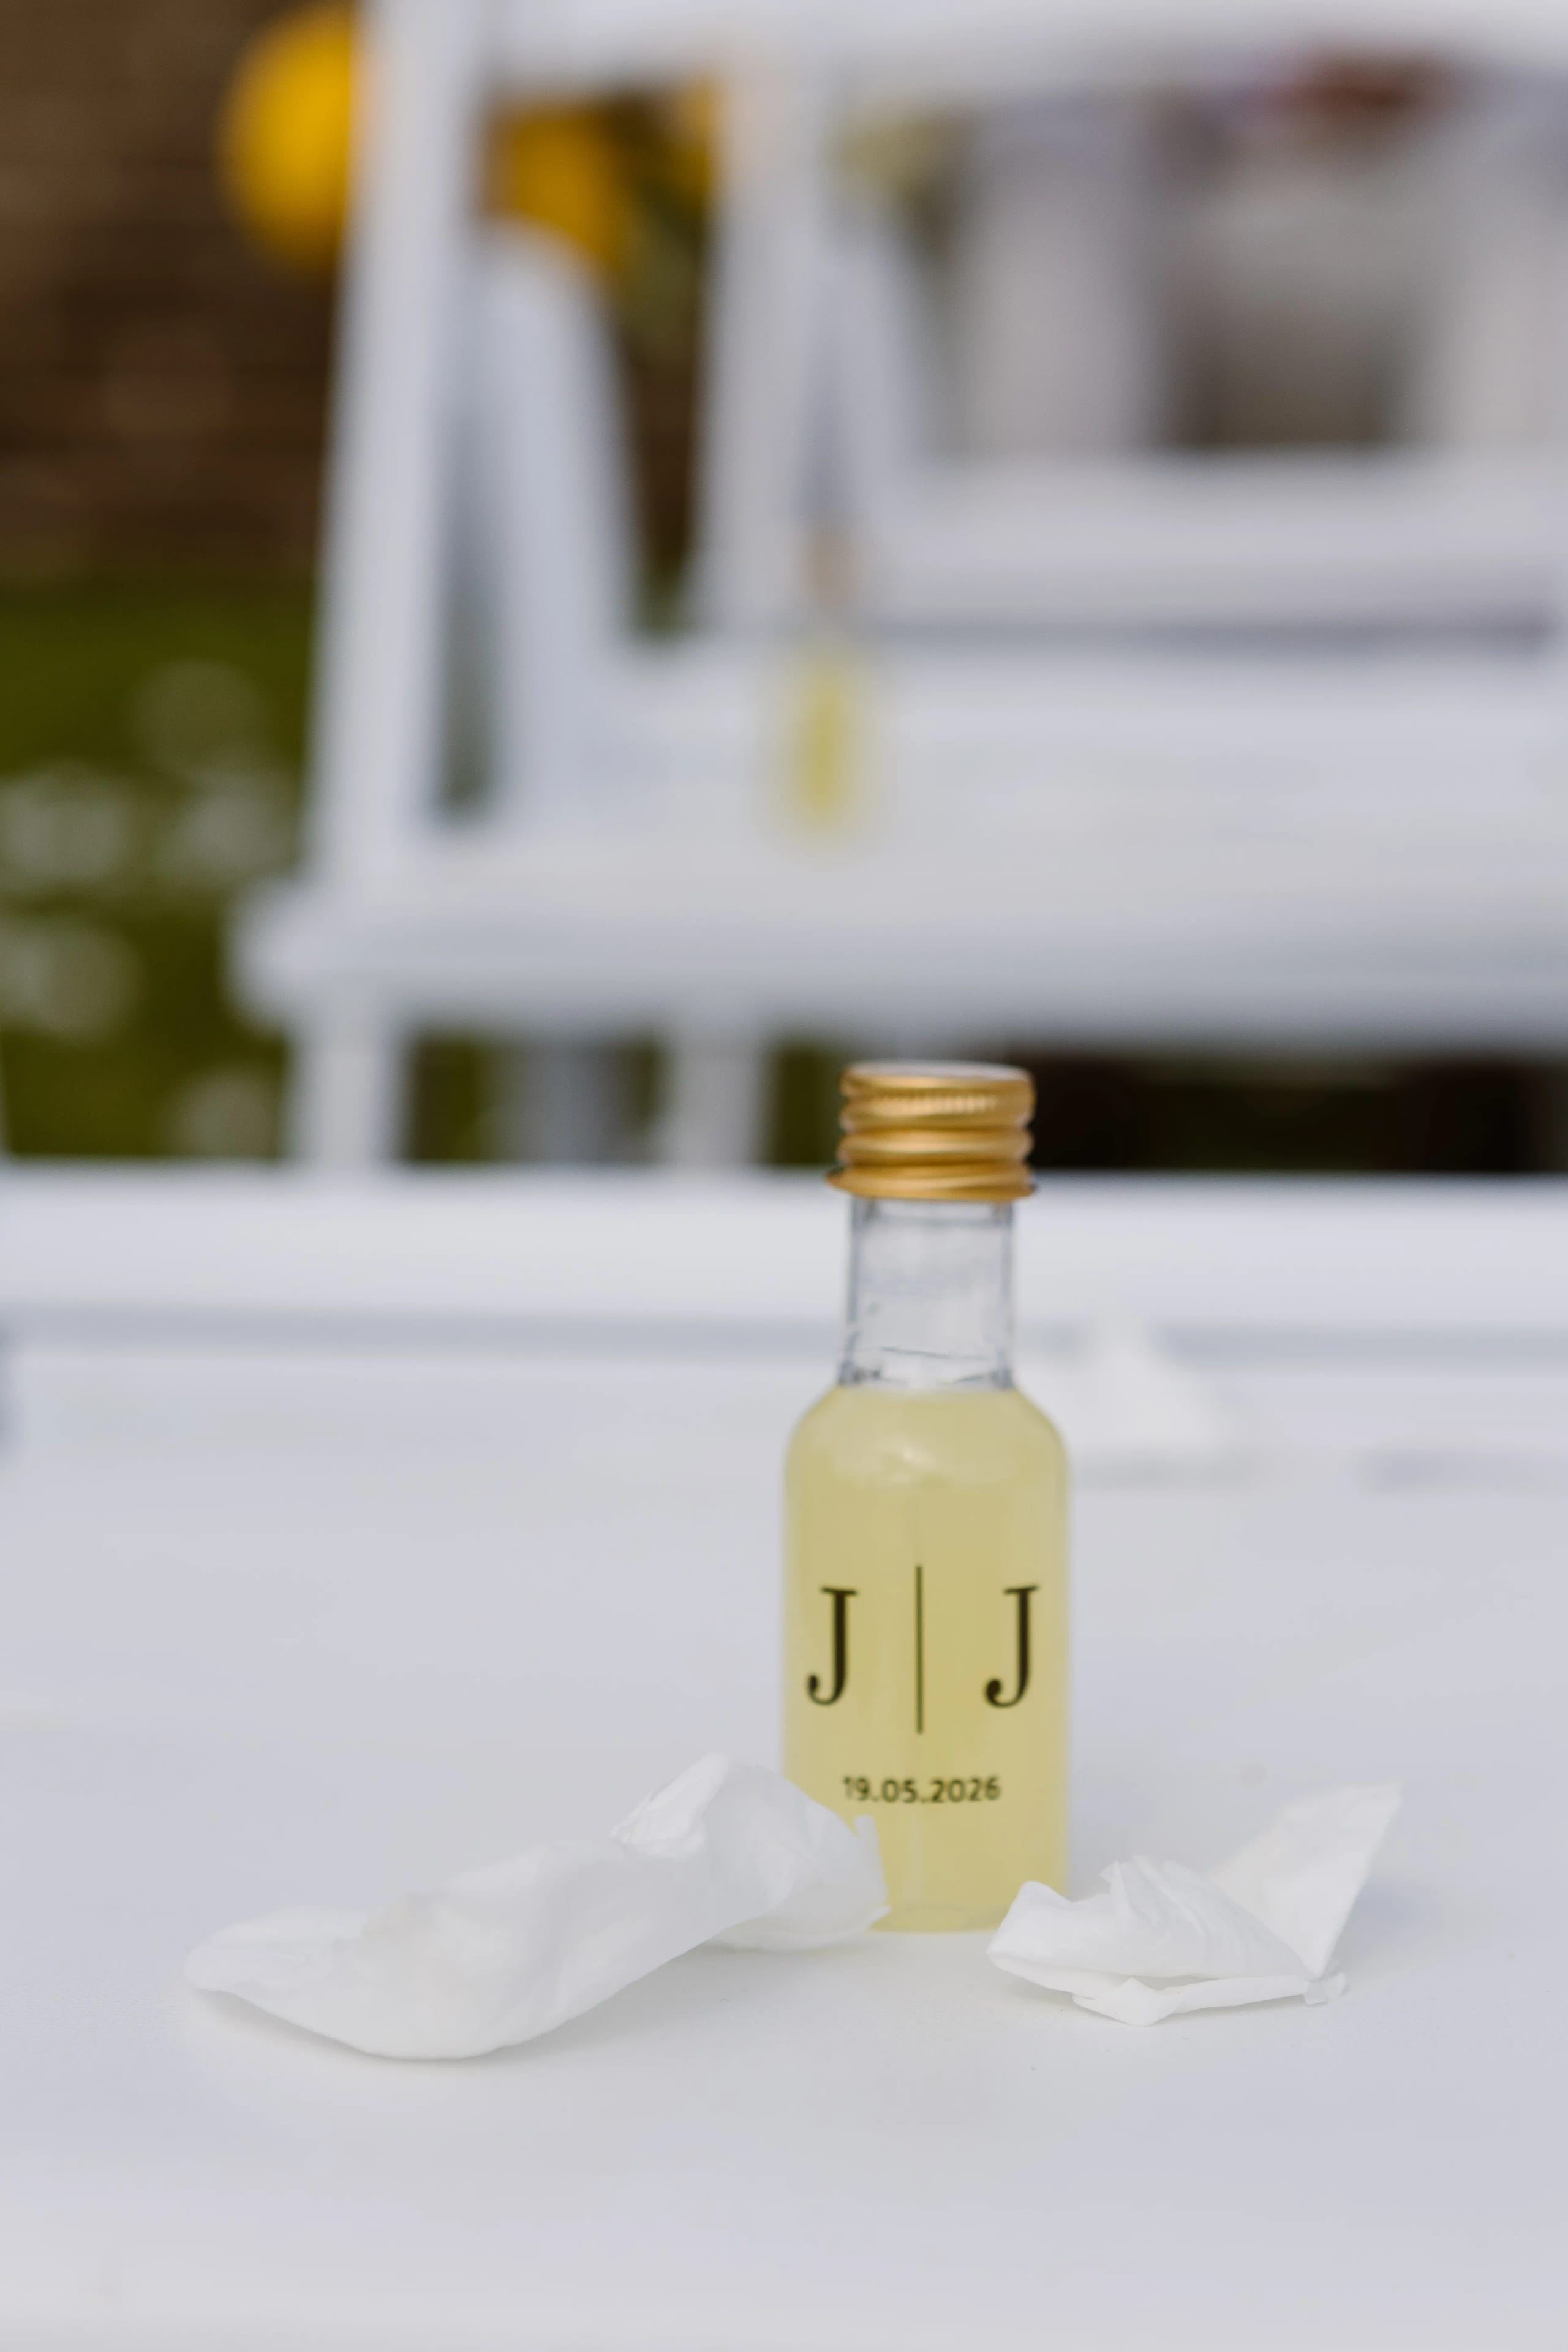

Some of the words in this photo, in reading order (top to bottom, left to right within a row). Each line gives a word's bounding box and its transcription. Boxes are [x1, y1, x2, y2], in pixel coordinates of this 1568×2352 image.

[806, 1586, 858, 1706] J
[983, 1585, 1039, 1708] J
[843, 1776, 1001, 1803] 19.05.2026
